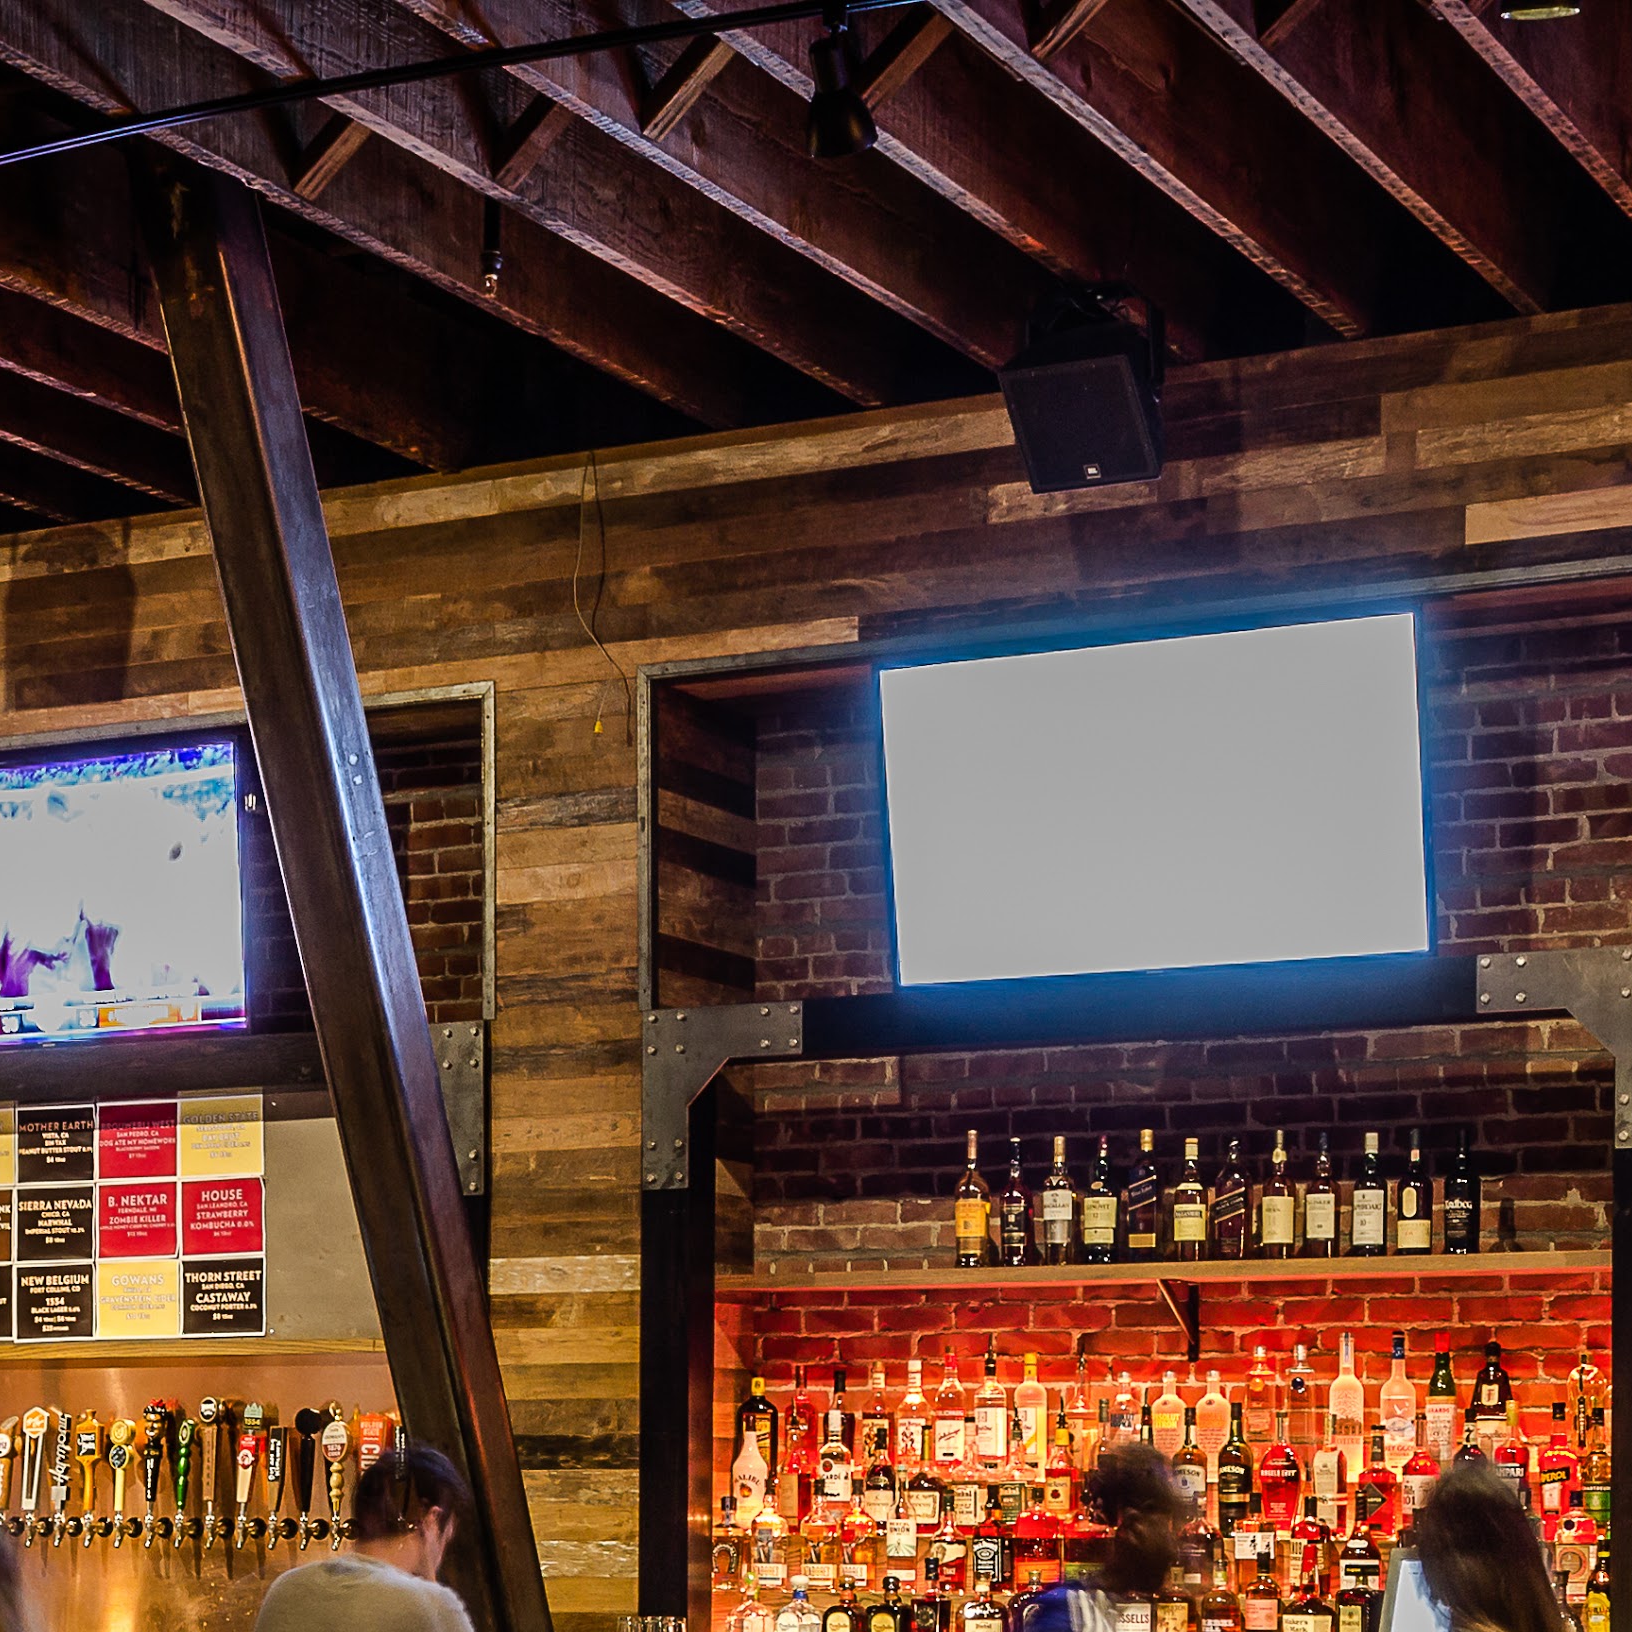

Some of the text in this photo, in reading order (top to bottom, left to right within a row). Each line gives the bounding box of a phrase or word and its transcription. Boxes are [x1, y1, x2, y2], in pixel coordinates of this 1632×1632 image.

[183, 1112, 258, 1124] GOLDEN STATE
[19, 1120, 94, 1133] MOTHER EARTH
[114, 1139, 126, 1147] ATE
[138, 1137, 176, 1146] HOMEWORK
[108, 1194, 167, 1207] B. NEKTAR
[201, 1189, 243, 1201] HOUSE
[18, 1199, 92, 1212] SIERRA NEVADA
[109, 1214, 166, 1224] ZOMBIE KILLER
[196, 1209, 249, 1220] STRAWBERRY
[190, 1220, 236, 1230] KOMBUCHA
[21, 1274, 90, 1287] NEW BELGIUM
[111, 1273, 164, 1287] GOWANS
[184, 1270, 262, 1284] THORN STREET
[196, 1292, 251, 1304] CASTAWAY
